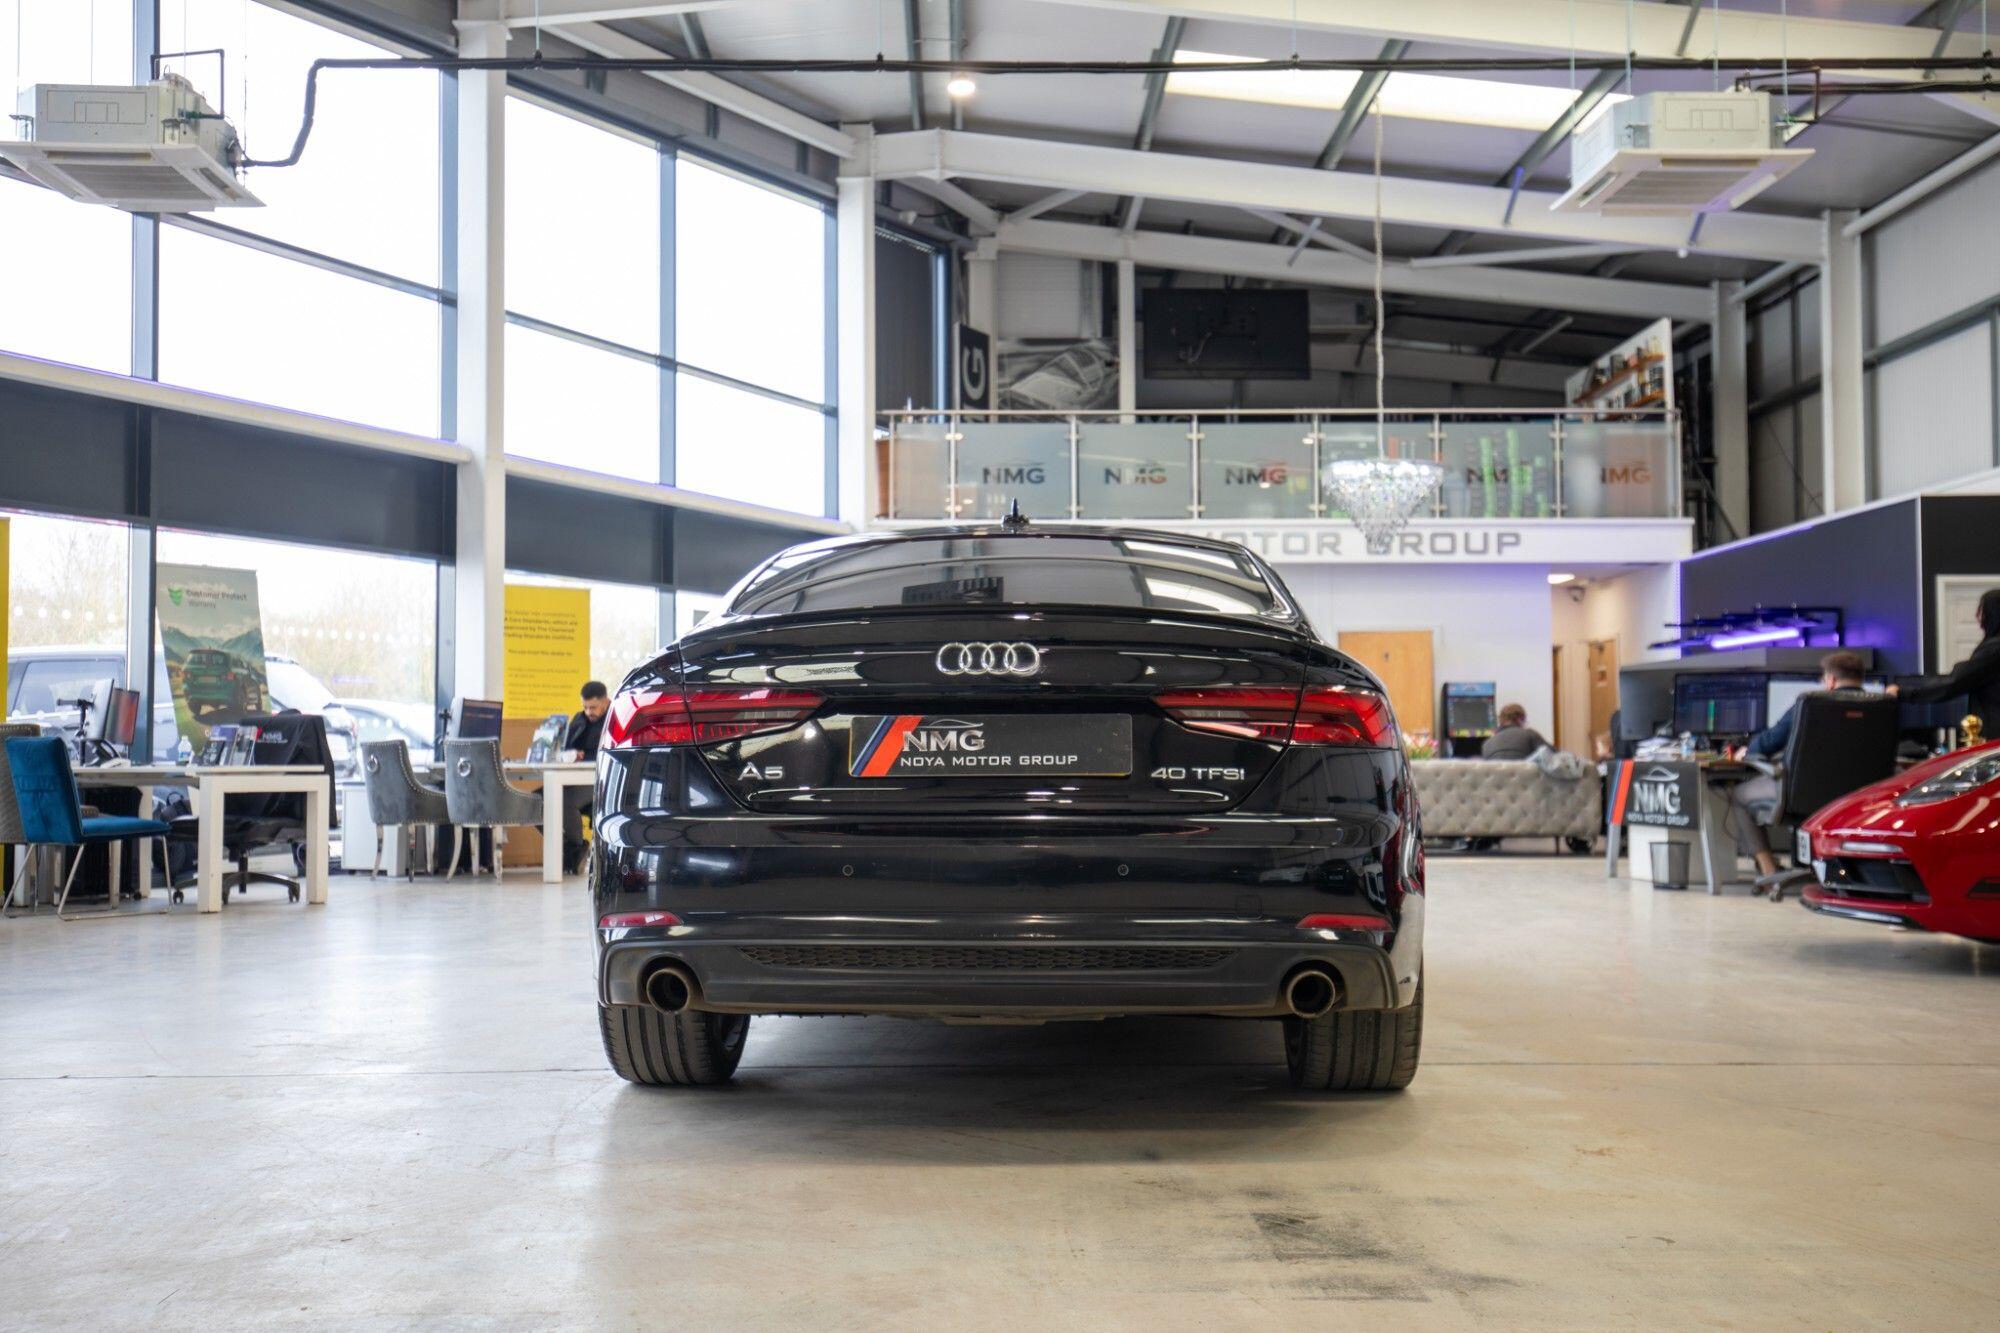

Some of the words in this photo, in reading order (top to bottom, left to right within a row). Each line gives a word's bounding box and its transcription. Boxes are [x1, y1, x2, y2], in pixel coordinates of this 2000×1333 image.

[983, 467, 1046, 485] NMG
[1225, 467, 1288, 485] NMG
[1206, 531, 1343, 556] OTOR
[901, 729, 985, 752] NMG
[900, 756, 945, 767] NOYA
[952, 755, 1012, 766] MOTOR
[1019, 754, 1078, 766] GROUP
[737, 761, 783, 780] A5
[1151, 767, 1186, 780] 40
[1191, 767, 1245, 780] TFSI
[1633, 782, 1681, 815] NMG
